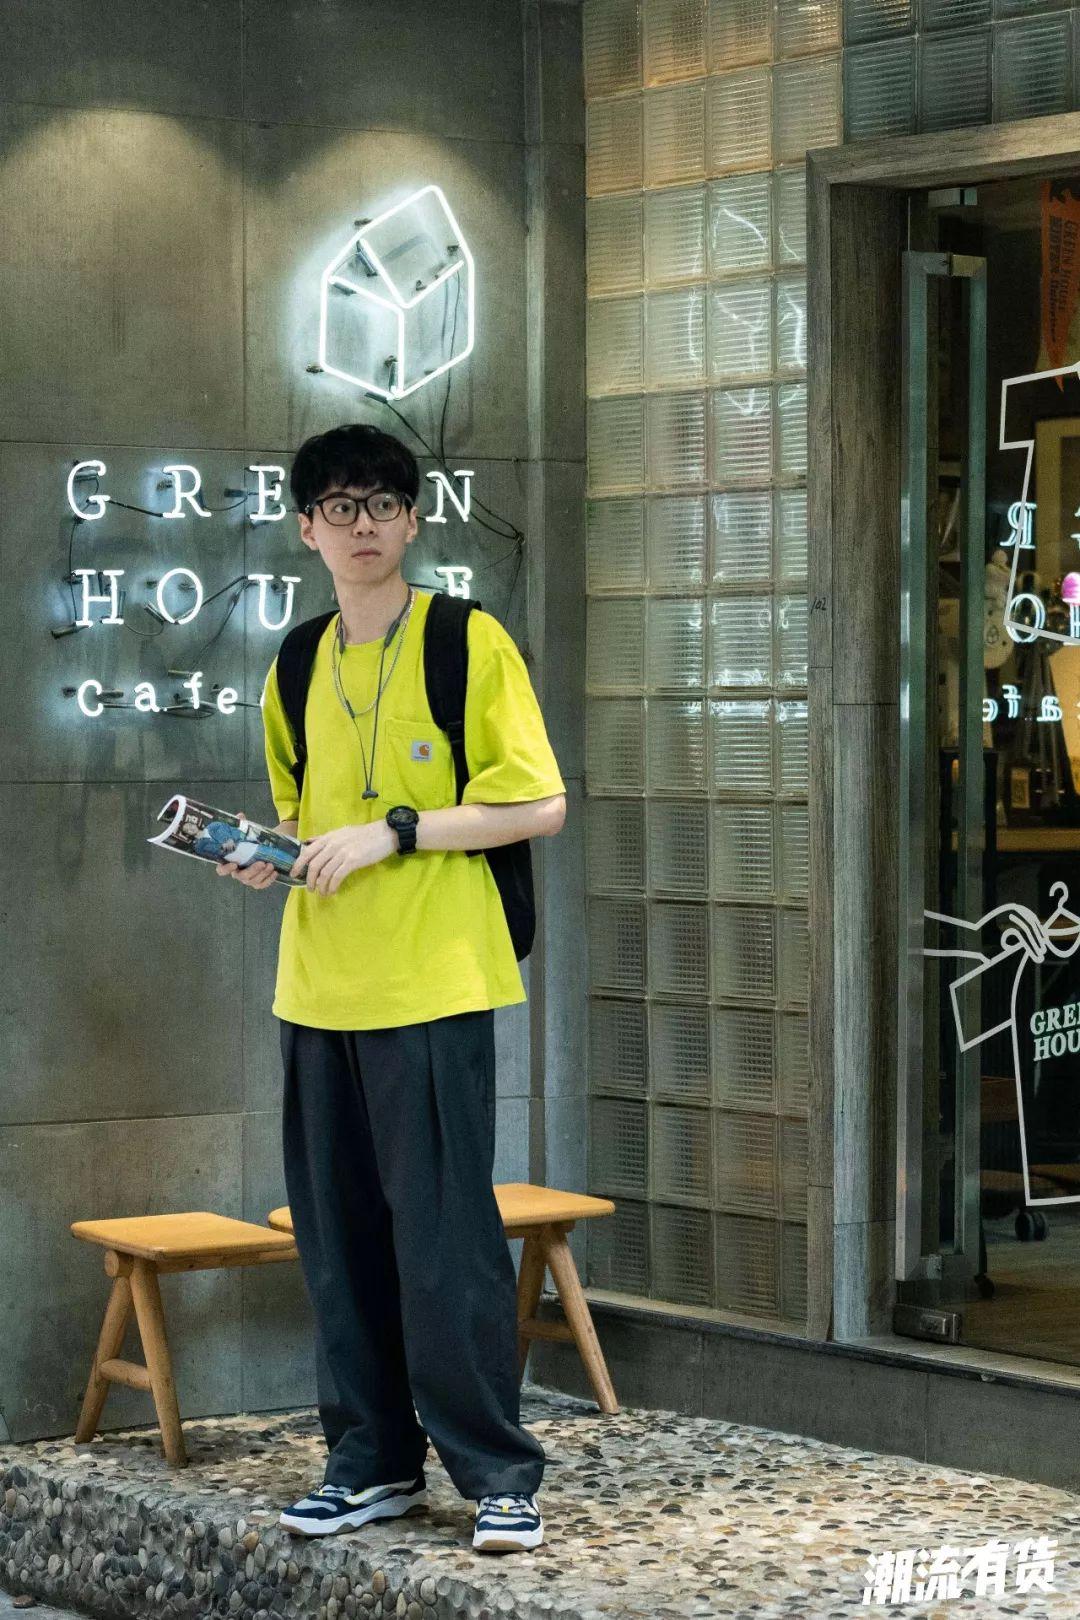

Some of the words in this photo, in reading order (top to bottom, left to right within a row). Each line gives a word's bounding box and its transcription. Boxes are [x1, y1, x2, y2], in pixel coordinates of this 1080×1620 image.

[66, 459, 475, 525] GREN
[75, 566, 473, 631] HOUE
[1029, 1001, 1080, 1036] GRE
